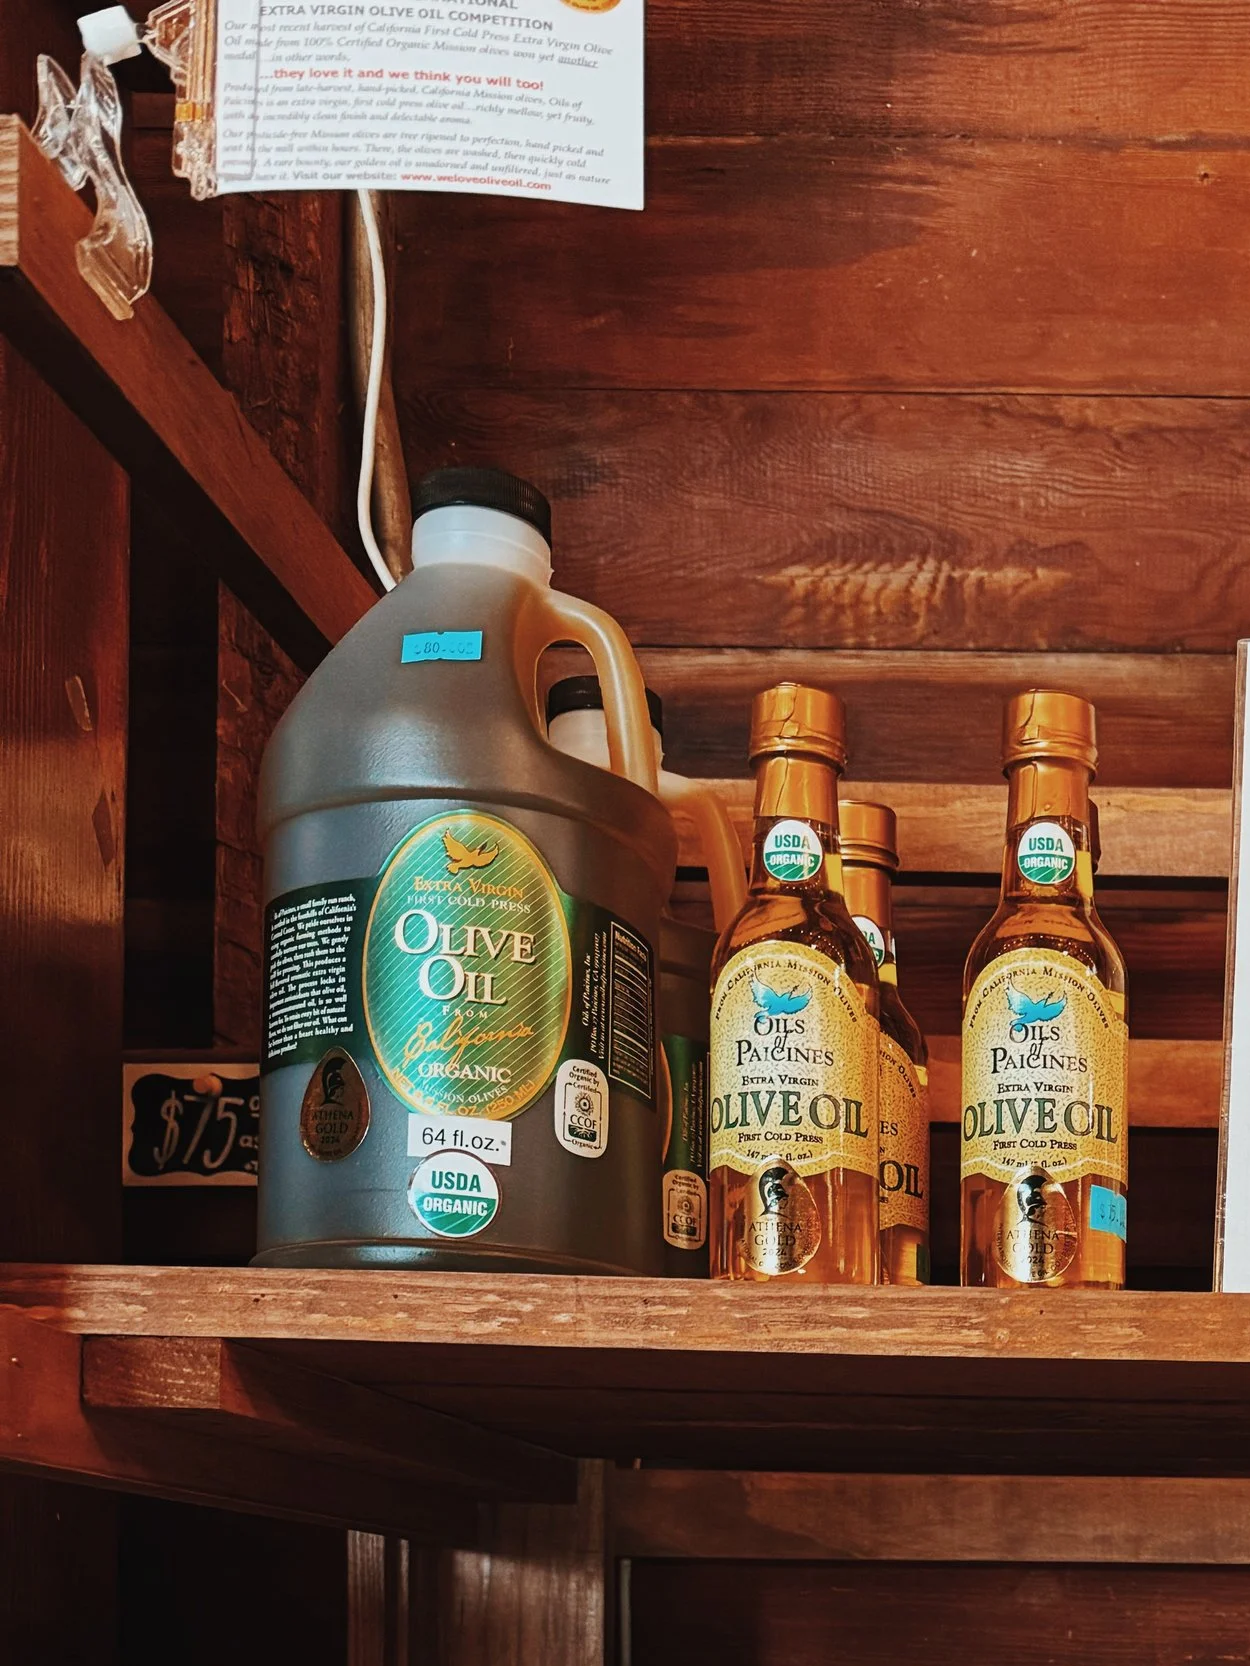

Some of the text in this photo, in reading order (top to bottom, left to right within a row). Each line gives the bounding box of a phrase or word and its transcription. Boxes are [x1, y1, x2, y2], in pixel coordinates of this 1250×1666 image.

[260, 5, 553, 31] EXTRA VIRGIN OLIVE OIL COMPETITION
[367, 23, 421, 34] California
[424, 25, 450, 36] First
[453, 27, 478, 38] Cold
[482, 31, 510, 41] Press
[513, 34, 543, 45] Extra
[547, 37, 580, 51] Virgin
[310, 68, 339, 78] love
[344, 68, 353, 77] it
[358, 69, 383, 79] and
[389, 71, 409, 79] we
[414, 70, 450, 81] think
[456, 73, 482, 84] you
[486, 75, 511, 86] will
[516, 79, 544, 90] too!
[293, 172, 318, 180] Visit
[400, 173, 552, 191] www.weloveoliveoil.com
[774, 834, 810, 851] USDA
[1028, 837, 1064, 853] USDA
[769, 854, 815, 869] ORGANIC
[1024, 856, 1068, 870] ORGANIC
[413, 876, 524, 898] EXTRA VIRGIN
[406, 894, 532, 913] FIRST COLD PRESS
[394, 909, 537, 964] OLIVE
[418, 954, 508, 1005] OIL
[787, 961, 831, 985] MISSION
[833, 987, 857, 1022] OLIVES
[969, 967, 1109, 1028] FROM CALIFORNIA MISSION OLIVES
[441, 1005, 488, 1019] FROM
[754, 1016, 805, 1035] OILS
[1009, 1023, 1060, 1043] OILS
[404, 1014, 534, 1068] California
[774, 1031, 794, 1053] of
[1030, 1040, 1048, 1061] of
[736, 1040, 834, 1066] PAICINES
[991, 1048, 1087, 1073] PAICINES
[418, 1062, 512, 1083] ORGANIC
[568, 1072, 600, 1087] Organic by
[572, 1065, 597, 1078] Certified
[742, 1075, 819, 1086] EXTRA VIRGIN
[468, 1085, 508, 1103] OLIVES
[998, 1082, 1074, 1094] EXTRA VIRGIN
[312, 1110, 353, 1120] ATHENA
[570, 1114, 596, 1129] CCOF
[711, 1091, 868, 1138] OLIVE OIL
[964, 1098, 1117, 1143] OLIVE OIL
[316, 1122, 348, 1133] GOLD
[422, 1127, 500, 1151] 64 fl.oz.
[738, 1132, 823, 1144] FIRST COLD PRESS
[993, 1139, 1077, 1150] FIRST COLD PRESS
[431, 1171, 482, 1193] USDA
[880, 1161, 923, 1199] OIL
[423, 1198, 488, 1217] ORGANIC
[749, 1222, 802, 1232] ATHENA
[755, 1235, 796, 1245] GOLD
